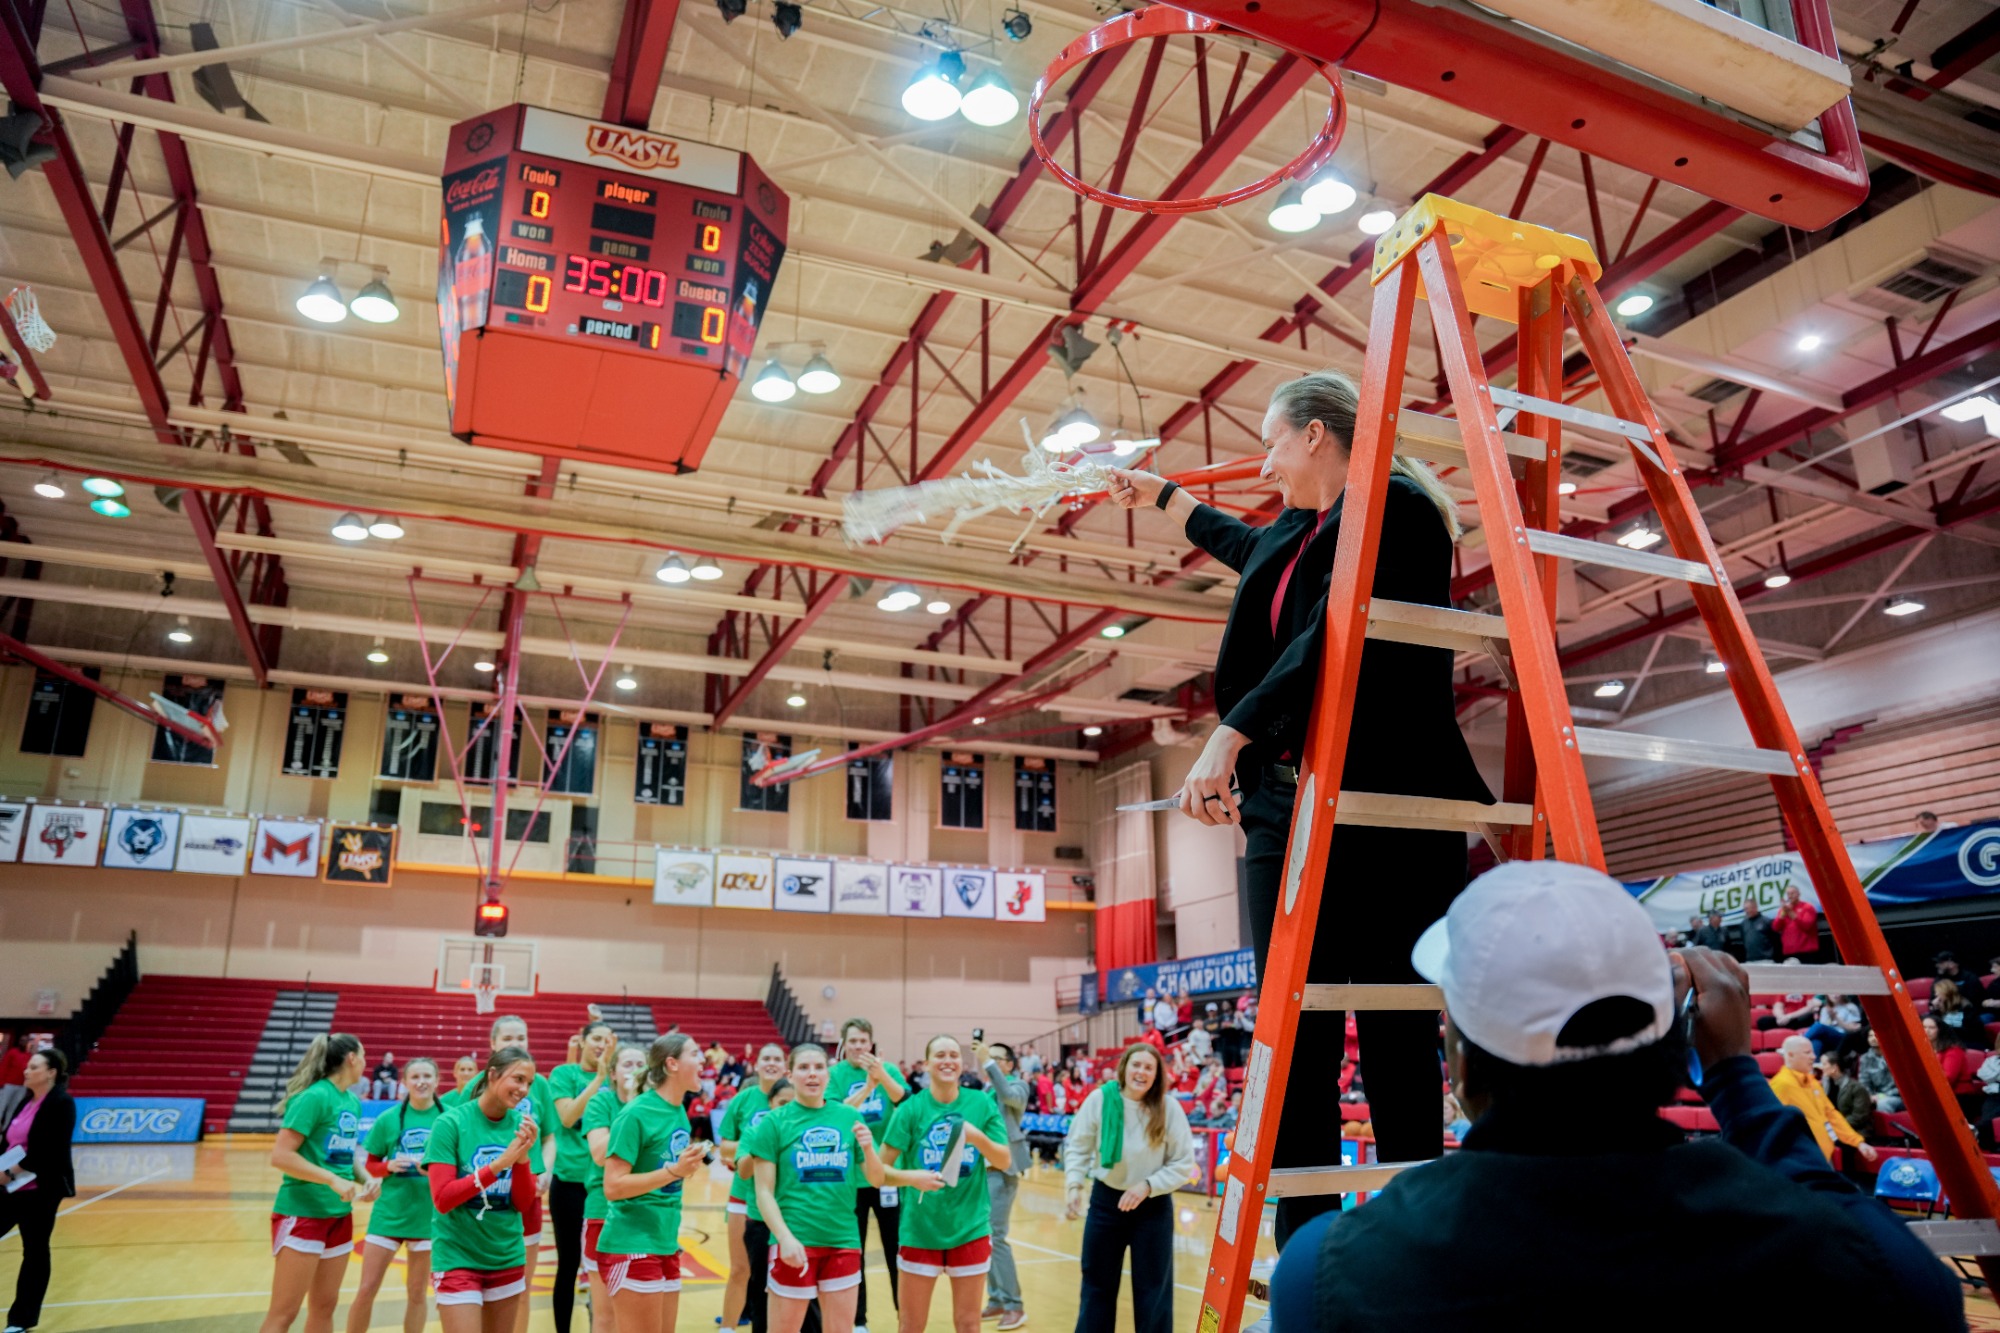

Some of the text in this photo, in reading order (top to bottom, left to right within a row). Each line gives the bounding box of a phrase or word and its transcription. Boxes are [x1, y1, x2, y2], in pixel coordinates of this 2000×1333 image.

[586, 125, 680, 170] UMSL
[522, 165, 557, 187] fouls
[530, 190, 550, 218] 0
[603, 182, 650, 204] player
[518, 223, 546, 240] won
[702, 225, 721, 252] 0
[506, 247, 548, 270] Home
[602, 241, 638, 258] game
[692, 258, 720, 274] won
[525, 274, 552, 313] 0
[565, 255, 668, 308] 35:00
[679, 280, 727, 305] Guests
[585, 318, 633, 340] period
[651, 324, 661, 349] 1
[701, 306, 726, 344] 0
[1702, 860, 1793, 888] CREATE YOUR
[1700, 879, 1790, 914] LEGACY
[1156, 961, 1257, 995] CHAMPIONS
[81, 1108, 181, 1134] GLVC
[796, 1151, 848, 1169] CHAMPIONS
